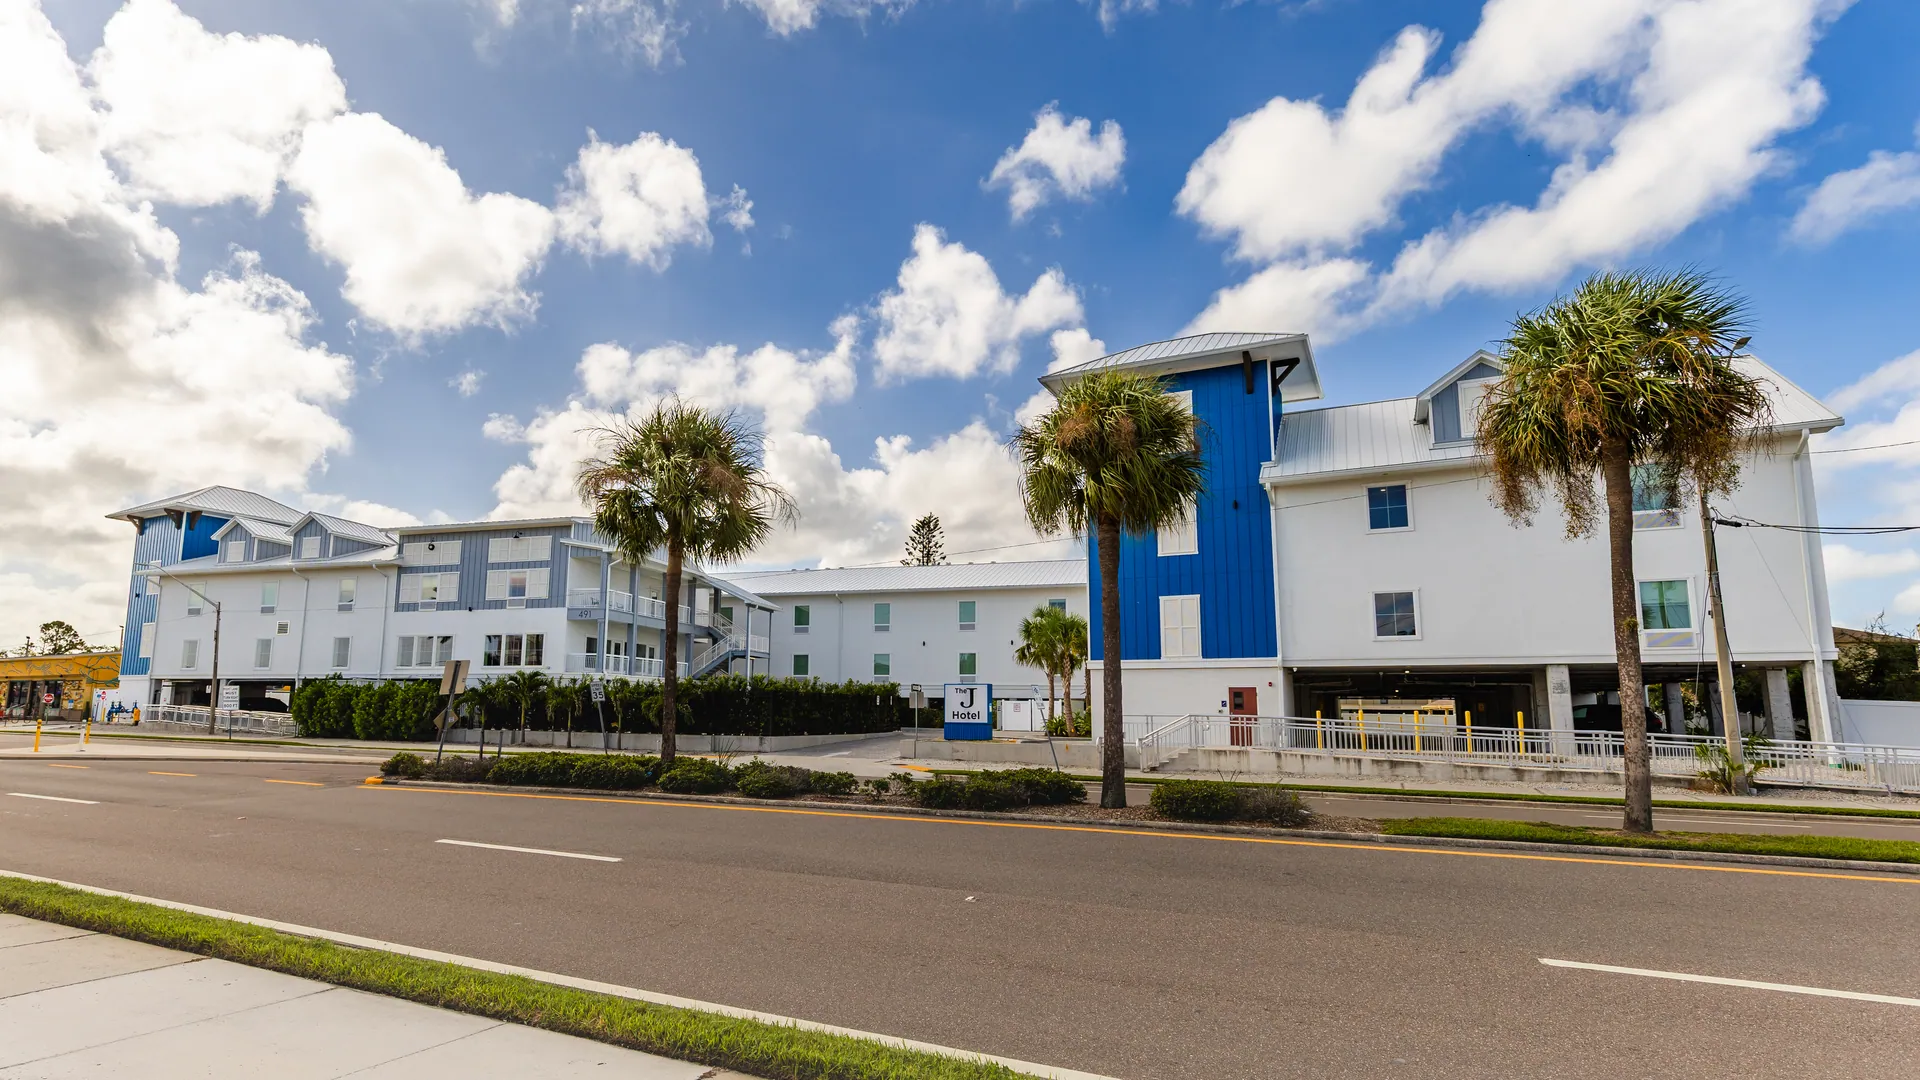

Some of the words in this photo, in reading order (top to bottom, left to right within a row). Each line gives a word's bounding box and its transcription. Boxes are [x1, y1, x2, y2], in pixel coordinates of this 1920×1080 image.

[578, 610, 592, 618] 491
[593, 691, 604, 700] 35
[960, 687, 977, 708] J
[952, 711, 980, 720] Hotel
